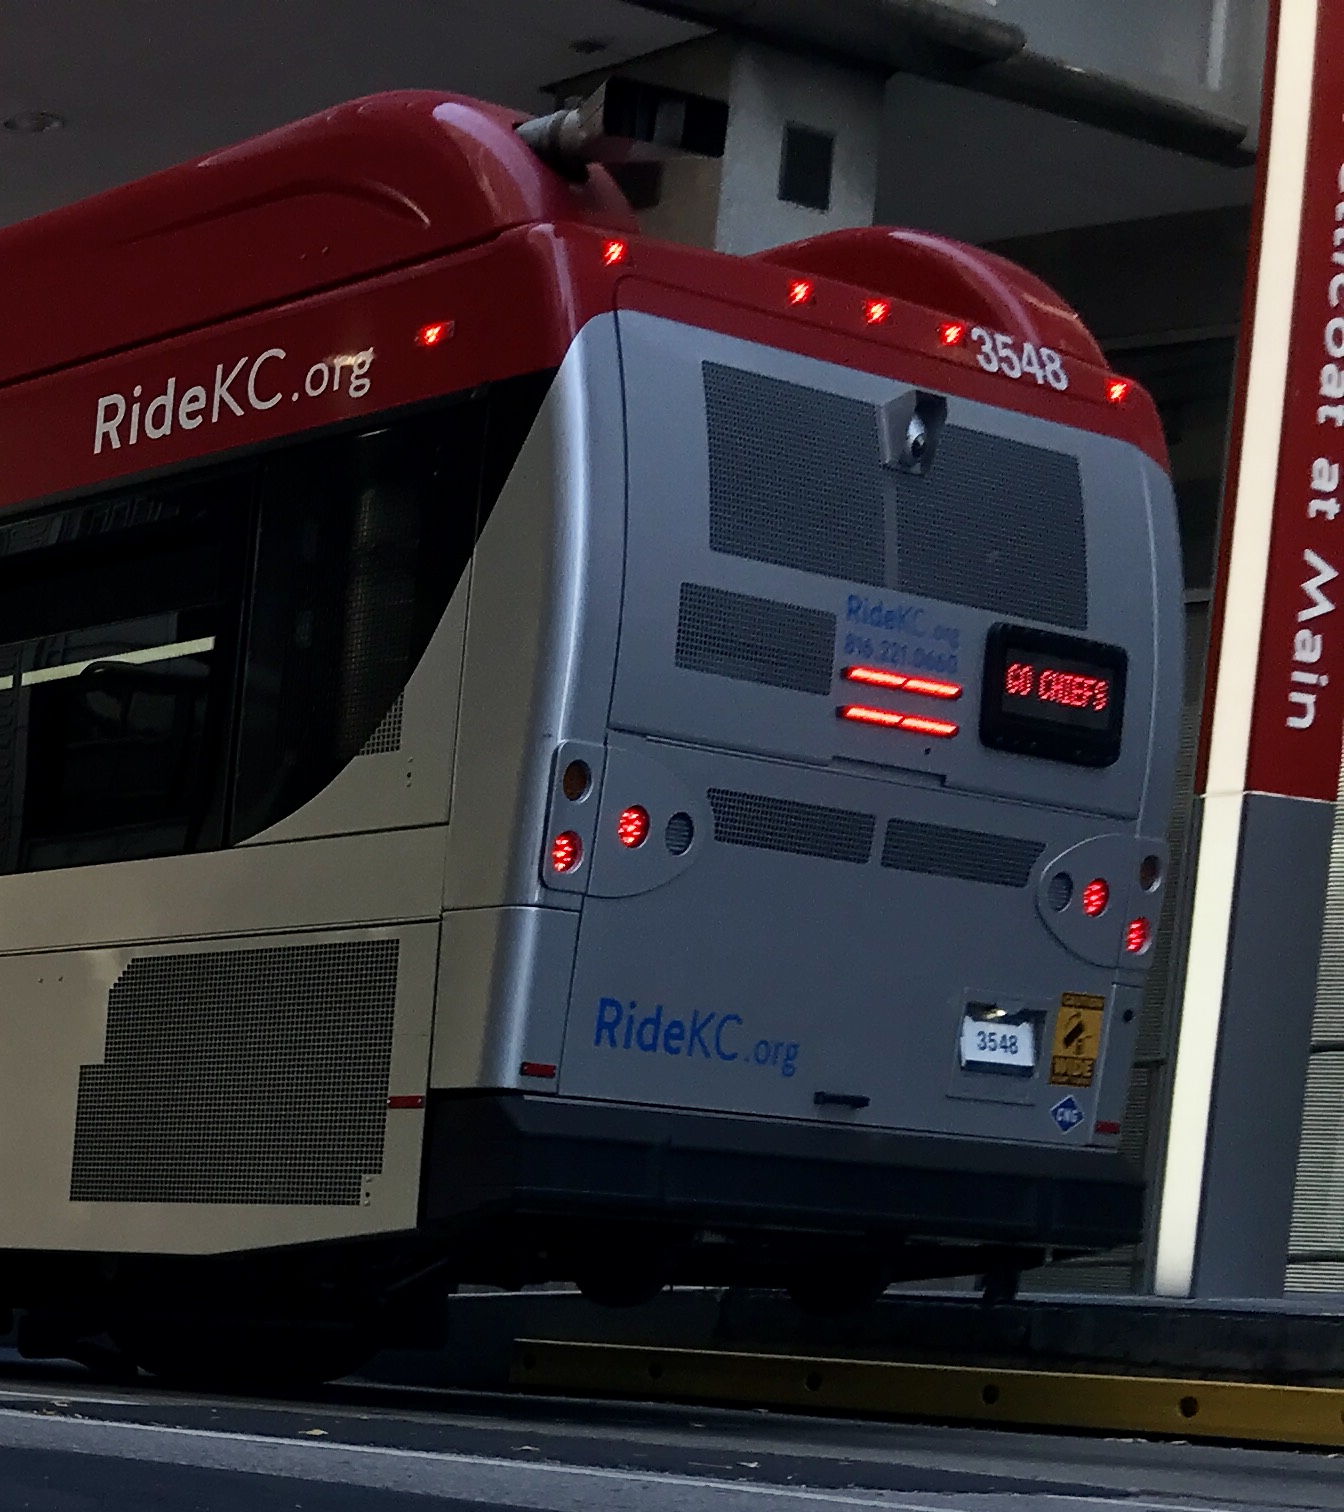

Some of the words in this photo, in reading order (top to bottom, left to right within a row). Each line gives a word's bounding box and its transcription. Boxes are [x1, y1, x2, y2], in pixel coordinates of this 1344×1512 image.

[970, 326, 1069, 392] 3548
[92, 346, 375, 455] RideKC.org
[1307, 456, 1341, 520] at
[1285, 548, 1340, 729] Main
[1004, 662, 1035, 697] GO
[1037, 668, 1110, 713] CHIEFS
[593, 996, 801, 1078] RideKC.org
[976, 1030, 1020, 1056] 3548
